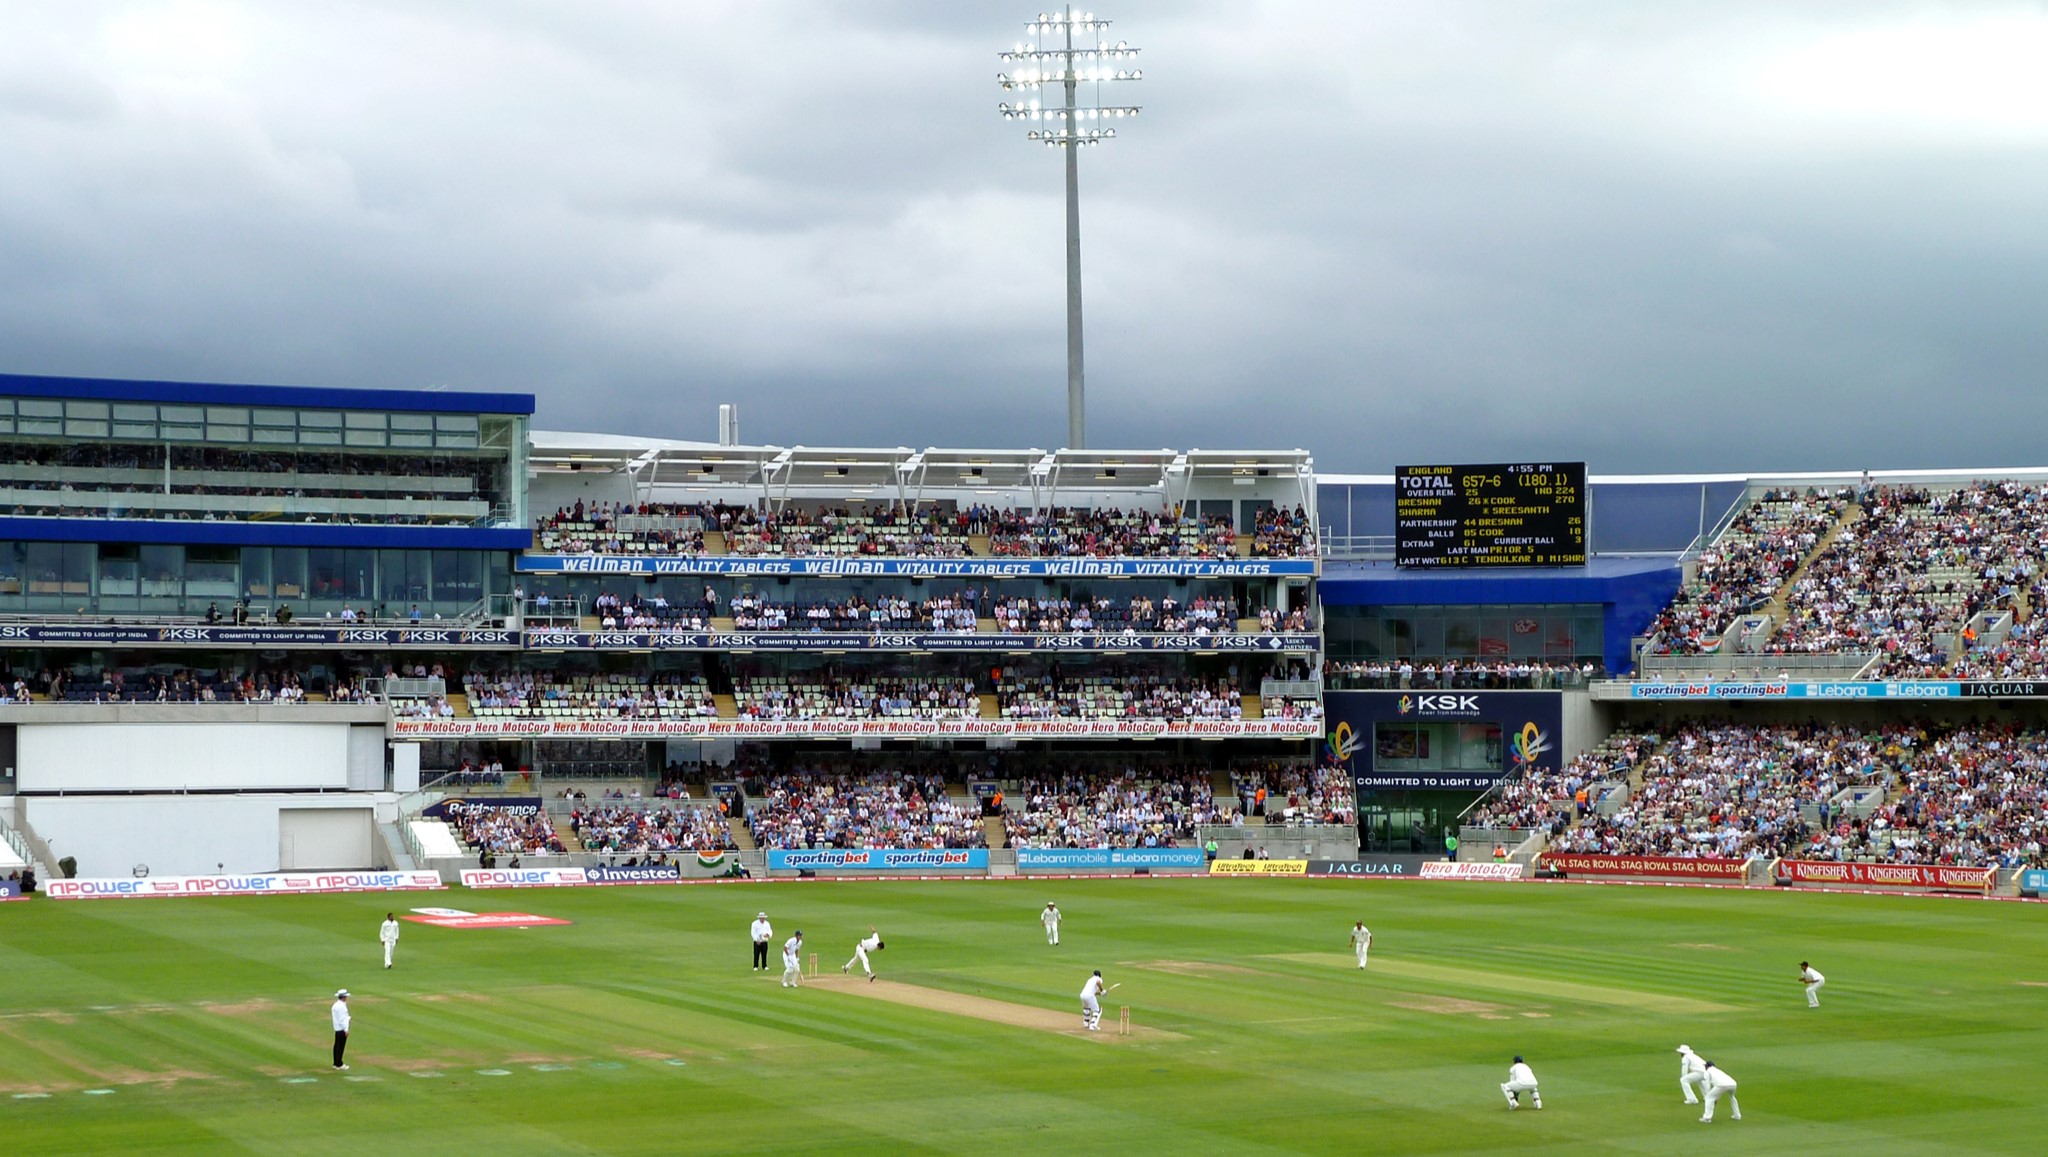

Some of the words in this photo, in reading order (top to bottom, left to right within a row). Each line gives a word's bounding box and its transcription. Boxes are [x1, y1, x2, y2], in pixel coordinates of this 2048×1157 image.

[1400, 476, 1452, 488] TOTAL
[1463, 475, 1501, 487] 657-6
[1493, 506, 1549, 514] SREESANTH
[654, 561, 724, 572] VITALITY
[730, 562, 790, 573] TABLETS
[896, 563, 965, 574] VITALITY
[969, 564, 1031, 574] TABLETS
[1135, 563, 1204, 574] VITALITY
[1208, 564, 1270, 575] TABLETS
[0, 627, 29, 637] SK
[170, 629, 210, 639] KSK
[350, 630, 388, 640] KSK
[411, 631, 448, 640] KSK
[471, 632, 509, 641] KSK
[540, 635, 578, 644] KSK
[600, 635, 637, 644] KSK
[659, 635, 697, 644] KSK
[718, 636, 756, 645] KSK
[880, 637, 916, 645] KSK
[1045, 637, 1082, 646] KSK
[1104, 637, 1141, 646] KSK
[1163, 637, 1200, 646] KSK
[1222, 637, 1259, 646] KSK
[1638, 685, 1710, 697] sportingbet
[1715, 685, 1787, 697] sportingbet
[1818, 685, 1867, 696] Lebara
[1899, 685, 1948, 696] Lebara
[1970, 684, 2034, 695] JAGUAR
[1418, 696, 1480, 710] KSK
[395, 722, 419, 732] Hero
[423, 722, 471, 734] MotoCorp
[475, 722, 498, 732] Hero
[502, 722, 550, 734] MotoCorp
[553, 722, 576, 732] Hero
[580, 722, 628, 734] MotoCorp
[631, 723, 654, 732] Hero
[658, 723, 705, 734] MotoCorp
[708, 723, 731, 733] Hero
[735, 723, 782, 735] MotoCorp
[785, 723, 808, 733] Hero
[812, 723, 859, 735] MotoCorp
[862, 722, 885, 732] Hero
[888, 722, 935, 734] MotoCorp
[939, 722, 961, 732] Hero
[965, 722, 1012, 734] MotoCorp
[1015, 722, 1038, 732] Hero
[1041, 722, 1088, 734] MotoCorp
[1092, 722, 1114, 732] Hero
[1118, 722, 1165, 734] MotoCorp
[1168, 722, 1190, 732] Hero
[1194, 722, 1241, 734] MotoCorp
[1244, 723, 1267, 732] Hero
[1271, 723, 1318, 734] MotoCorp
[1357, 777, 1420, 786] COMMITTED
[1423, 778, 1438, 786] TO
[1441, 778, 1471, 786] LIGHT
[785, 852, 869, 865] sportingbet
[885, 852, 969, 865] sportingbet
[1027, 853, 1067, 863] Lebara
[1068, 853, 1108, 863] mobile
[1121, 853, 1159, 863] Lebara
[1160, 855, 1200, 865] money
[1328, 863, 1403, 874] JAGUAR
[1422, 863, 1452, 873] Hero
[1457, 864, 1521, 876] MotoCorp
[1569, 859, 1590, 868] STAG
[1592, 860, 1618, 869] ROYAL
[1621, 861, 1643, 870] STAG
[1644, 862, 1670, 871] ROYAL
[1672, 863, 1694, 871] STAG
[1697, 863, 1723, 872] ROYAL
[604, 868, 677, 880] Investec
[1797, 863, 1849, 879] KINGFISHER
[1867, 867, 1920, 882] KINGFISHER
